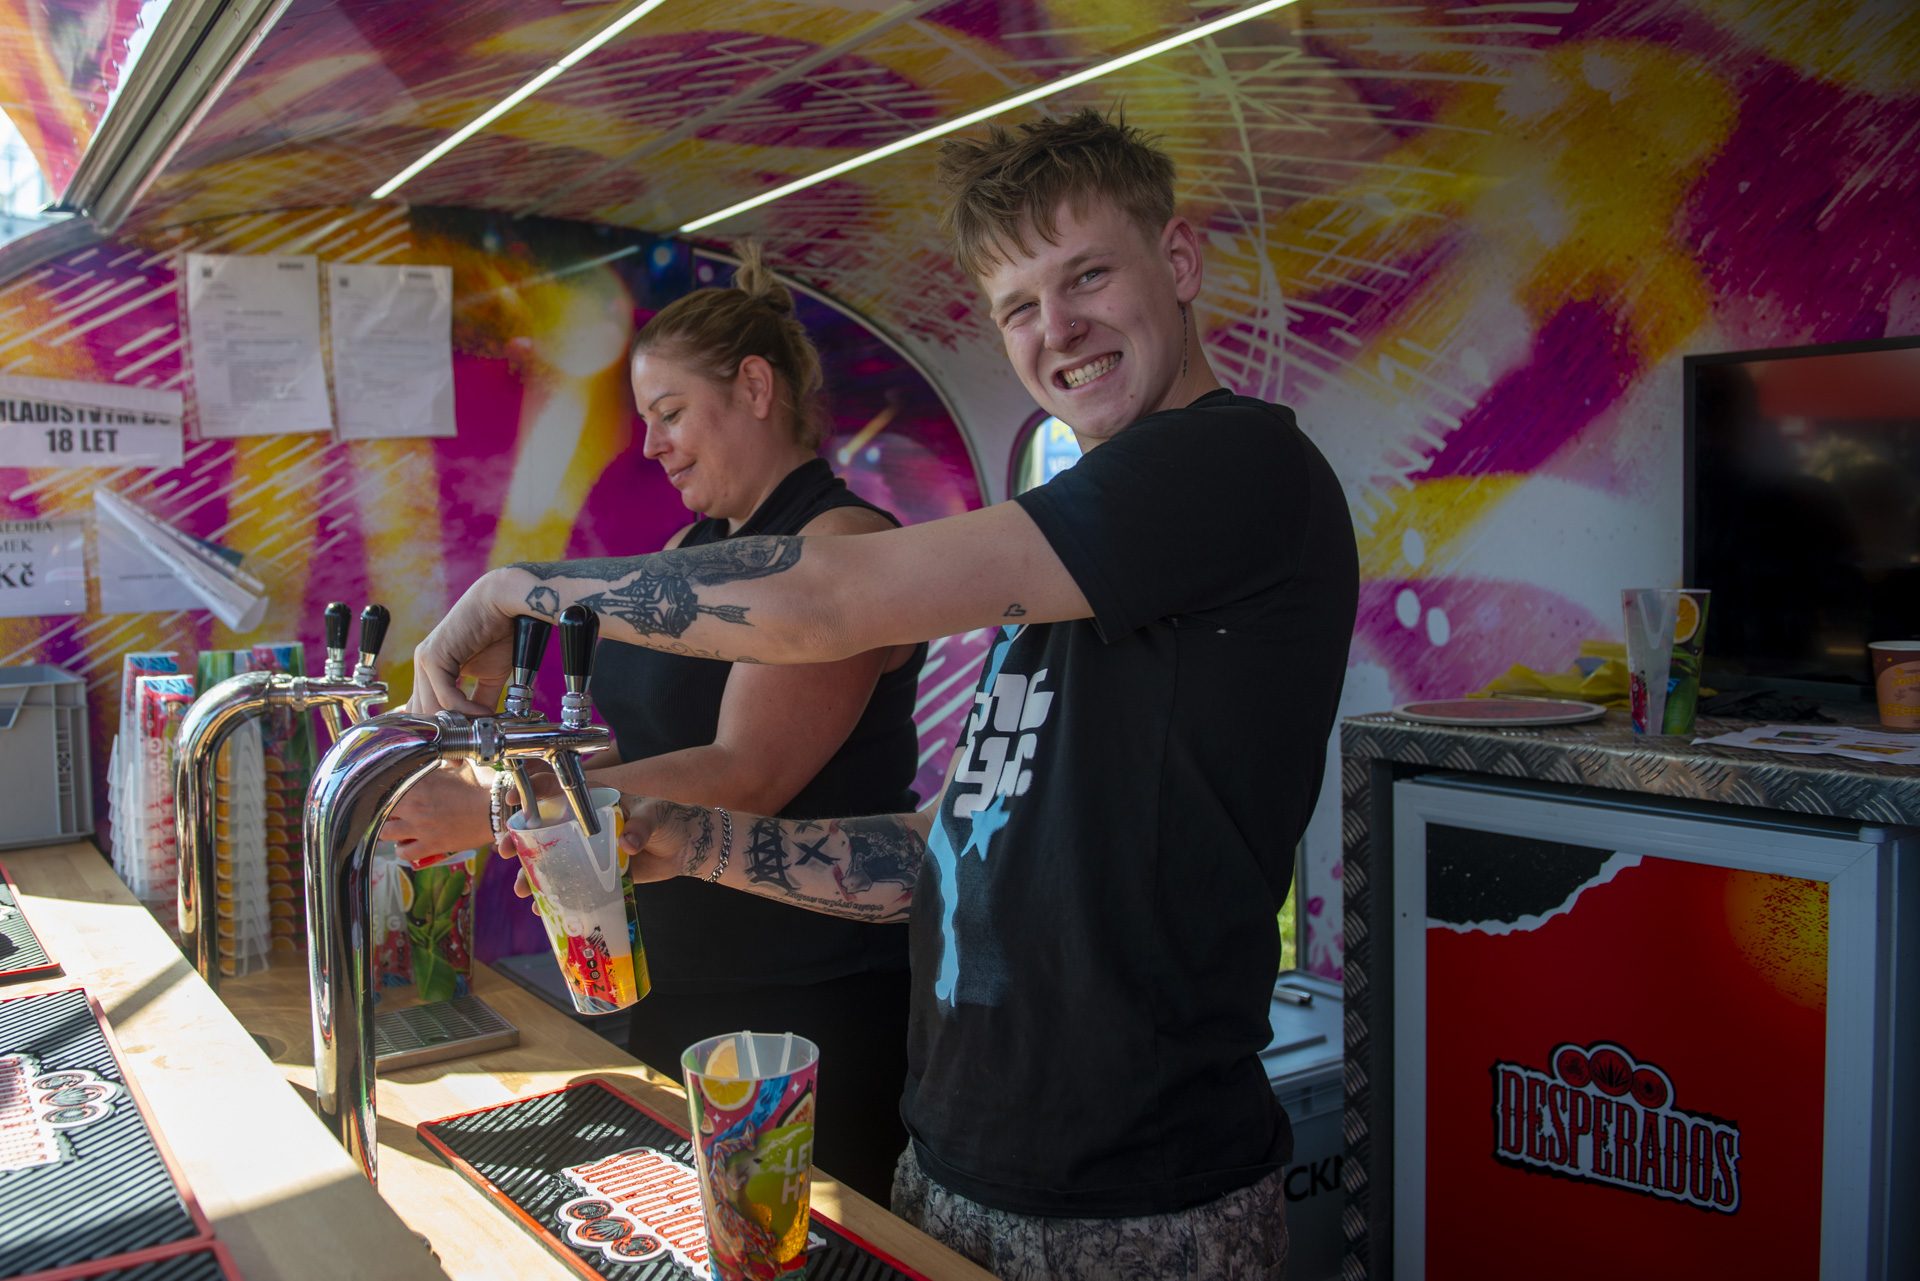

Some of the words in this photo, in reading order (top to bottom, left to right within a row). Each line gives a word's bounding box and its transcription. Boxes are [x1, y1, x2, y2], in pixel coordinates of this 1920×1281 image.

[46, 429, 73, 452] 18
[81, 429, 118, 452] LET
[1497, 1064, 1741, 1212] DESPERADOS
